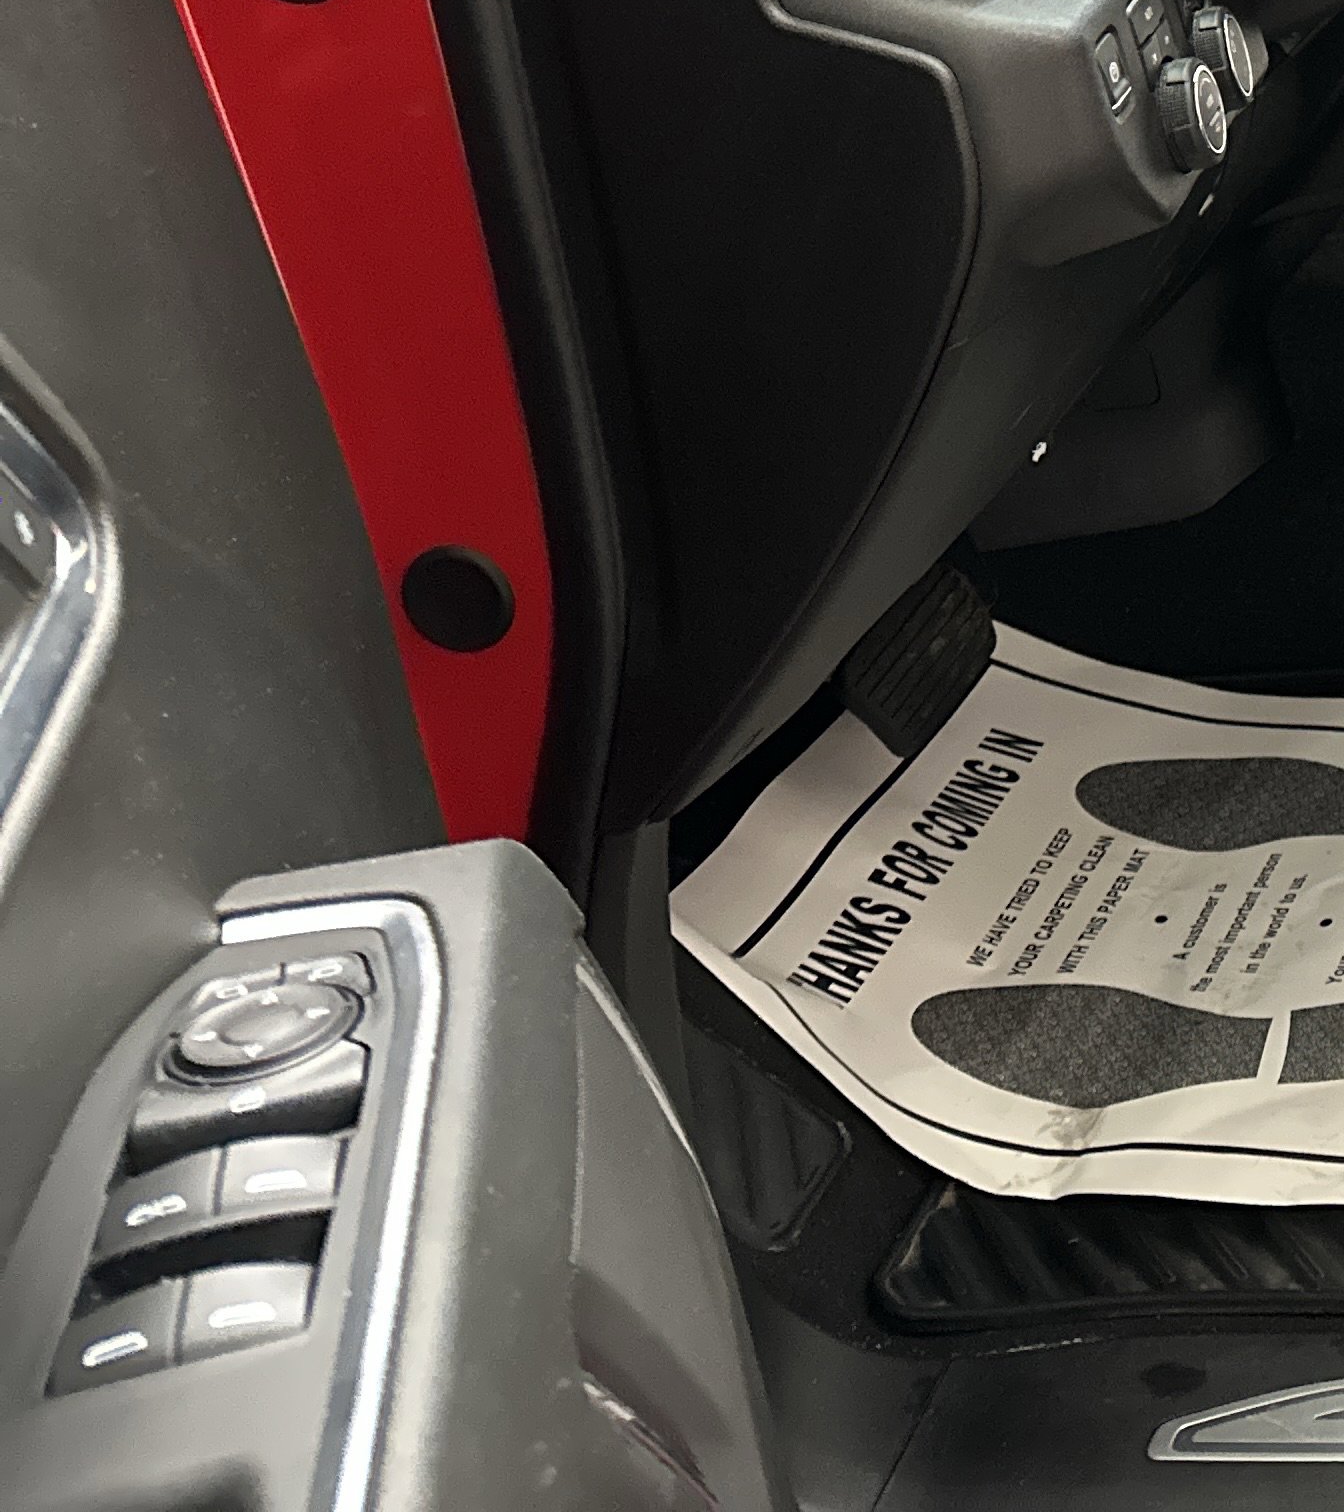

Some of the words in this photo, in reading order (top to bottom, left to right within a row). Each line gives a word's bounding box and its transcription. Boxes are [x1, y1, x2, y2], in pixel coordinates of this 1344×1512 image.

[867, 840, 954, 901] FOR
[912, 759, 1020, 851] COMING
[979, 728, 1044, 763] IN
[1253, 854, 1282, 888] person
[1289, 874, 1308, 889] us.
[966, 945, 992, 966] WE
[983, 914, 1016, 946] HAVE
[1006, 878, 1040, 911] TRIED
[1031, 860, 1053, 875] TO
[1043, 828, 1072, 858] KEEP
[1007, 943, 1045, 977] YOUR
[1034, 874, 1088, 941] CARPETING
[1080, 836, 1115, 872] CLEAN
[1057, 944, 1089, 974] WITH
[1078, 916, 1107, 940] THIS
[1098, 875, 1134, 914] PAPER
[1123, 848, 1150, 873] MAT
[1279, 893, 1297, 904] to
[1173, 952, 1190, 960] A
[1183, 896, 1219, 949] customer
[1208, 883, 1227, 892] is
[1218, 891, 1261, 943] important
[1263, 908, 1289, 938] world
[1206, 946, 1231, 974] most
[1248, 942, 1271, 959] the
[1240, 963, 1260, 973] in
